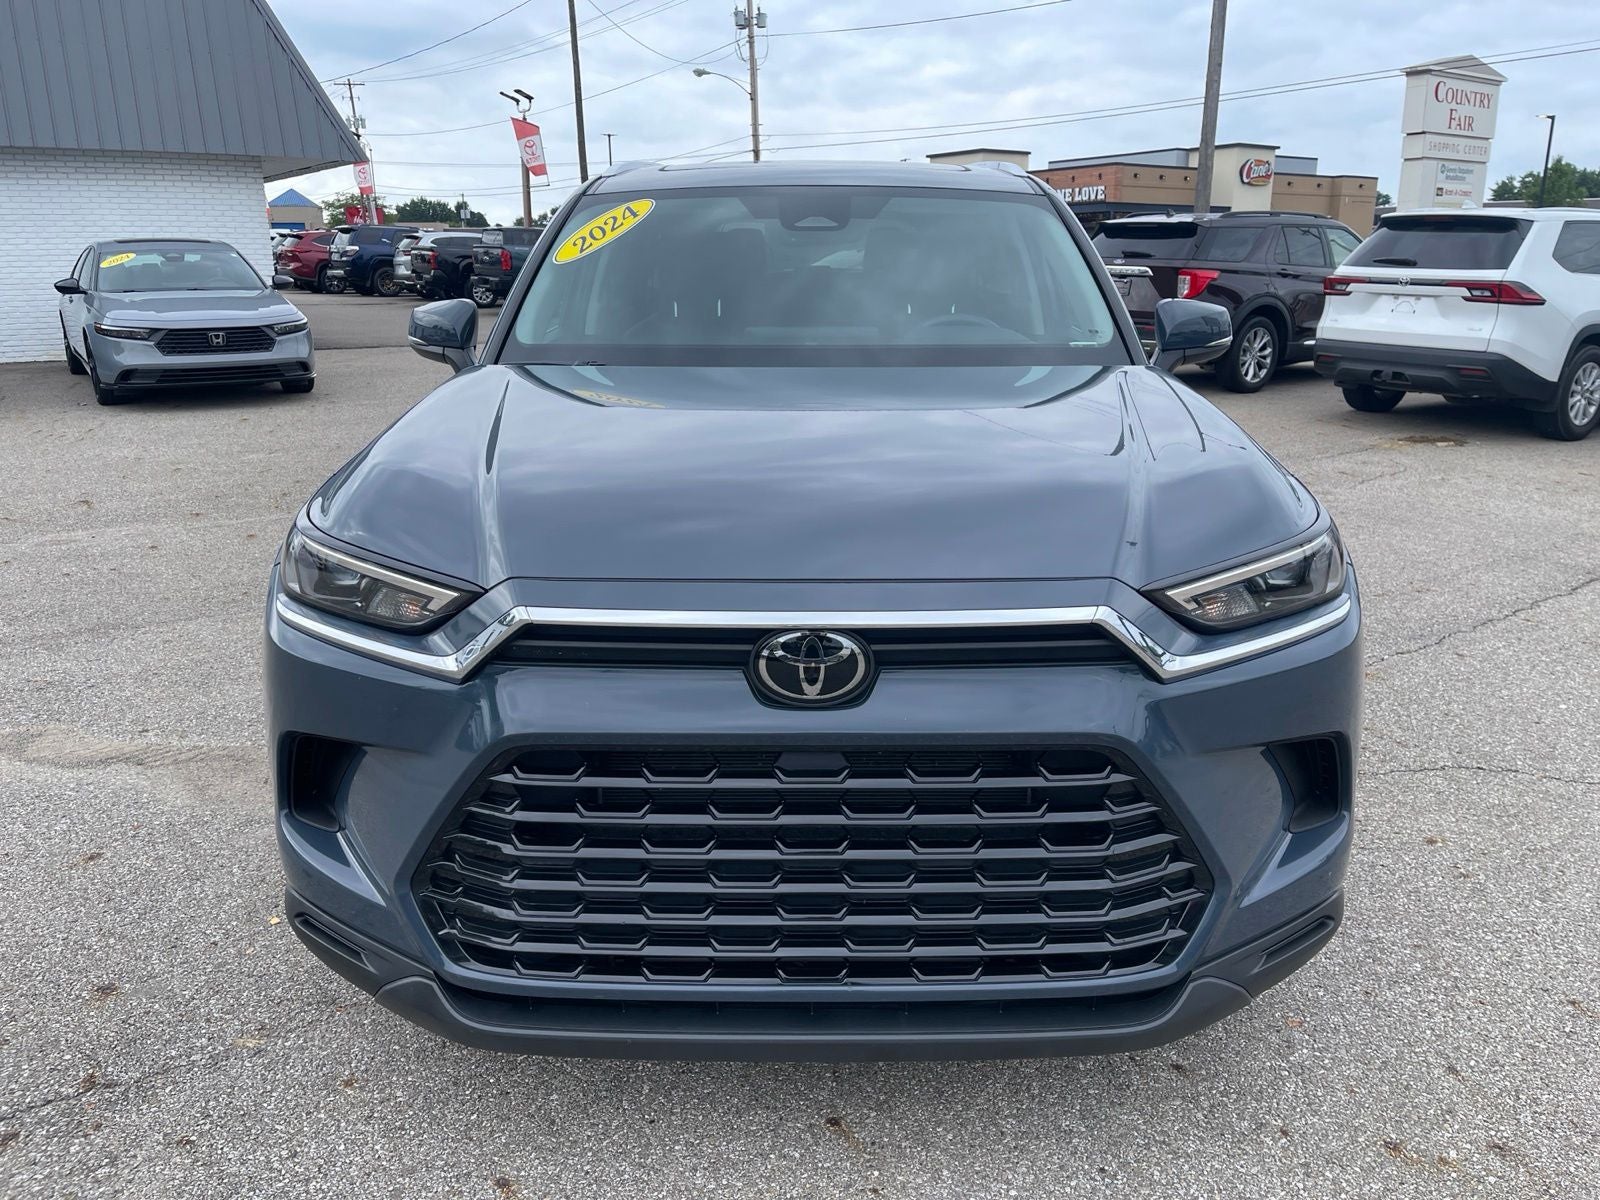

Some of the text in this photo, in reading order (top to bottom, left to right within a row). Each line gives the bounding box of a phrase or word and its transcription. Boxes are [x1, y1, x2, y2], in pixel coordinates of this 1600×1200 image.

[1434, 80, 1493, 109] COUNTRY
[1448, 108, 1474, 132] FAIR
[1429, 141, 1488, 156] SHOPPING CENTER
[1074, 185, 1105, 201] LOVE
[572, 205, 640, 254] 2024
